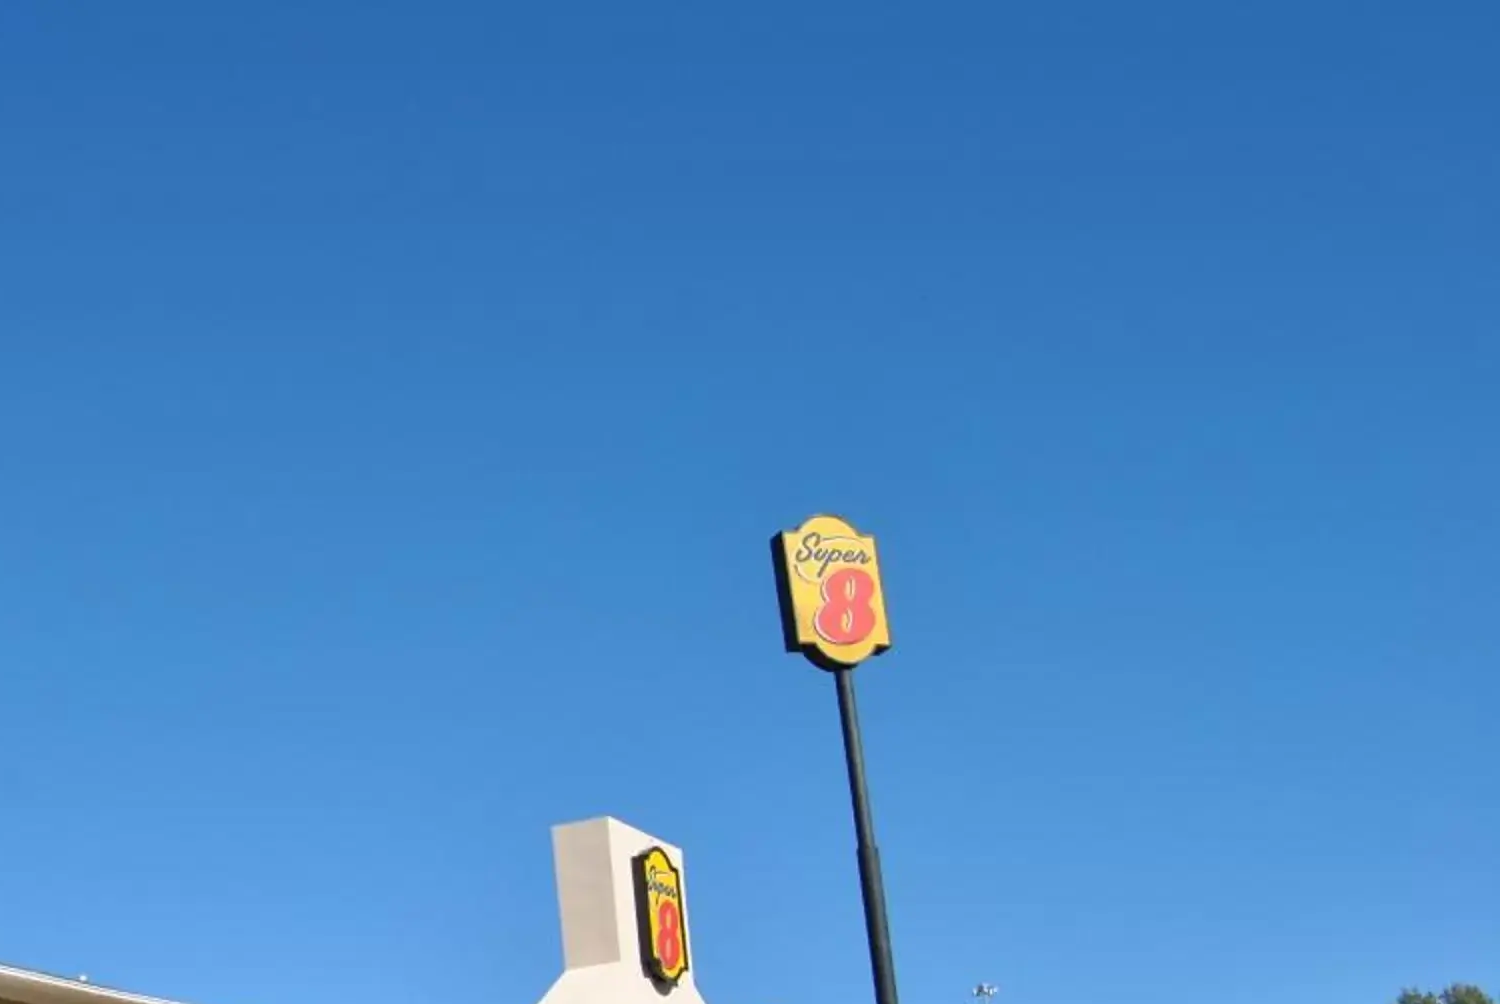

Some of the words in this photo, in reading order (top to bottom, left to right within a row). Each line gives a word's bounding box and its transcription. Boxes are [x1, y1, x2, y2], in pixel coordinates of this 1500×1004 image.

[795, 532, 871, 578] Super
[814, 568, 876, 645] 8
[658, 901, 680, 970] 8
